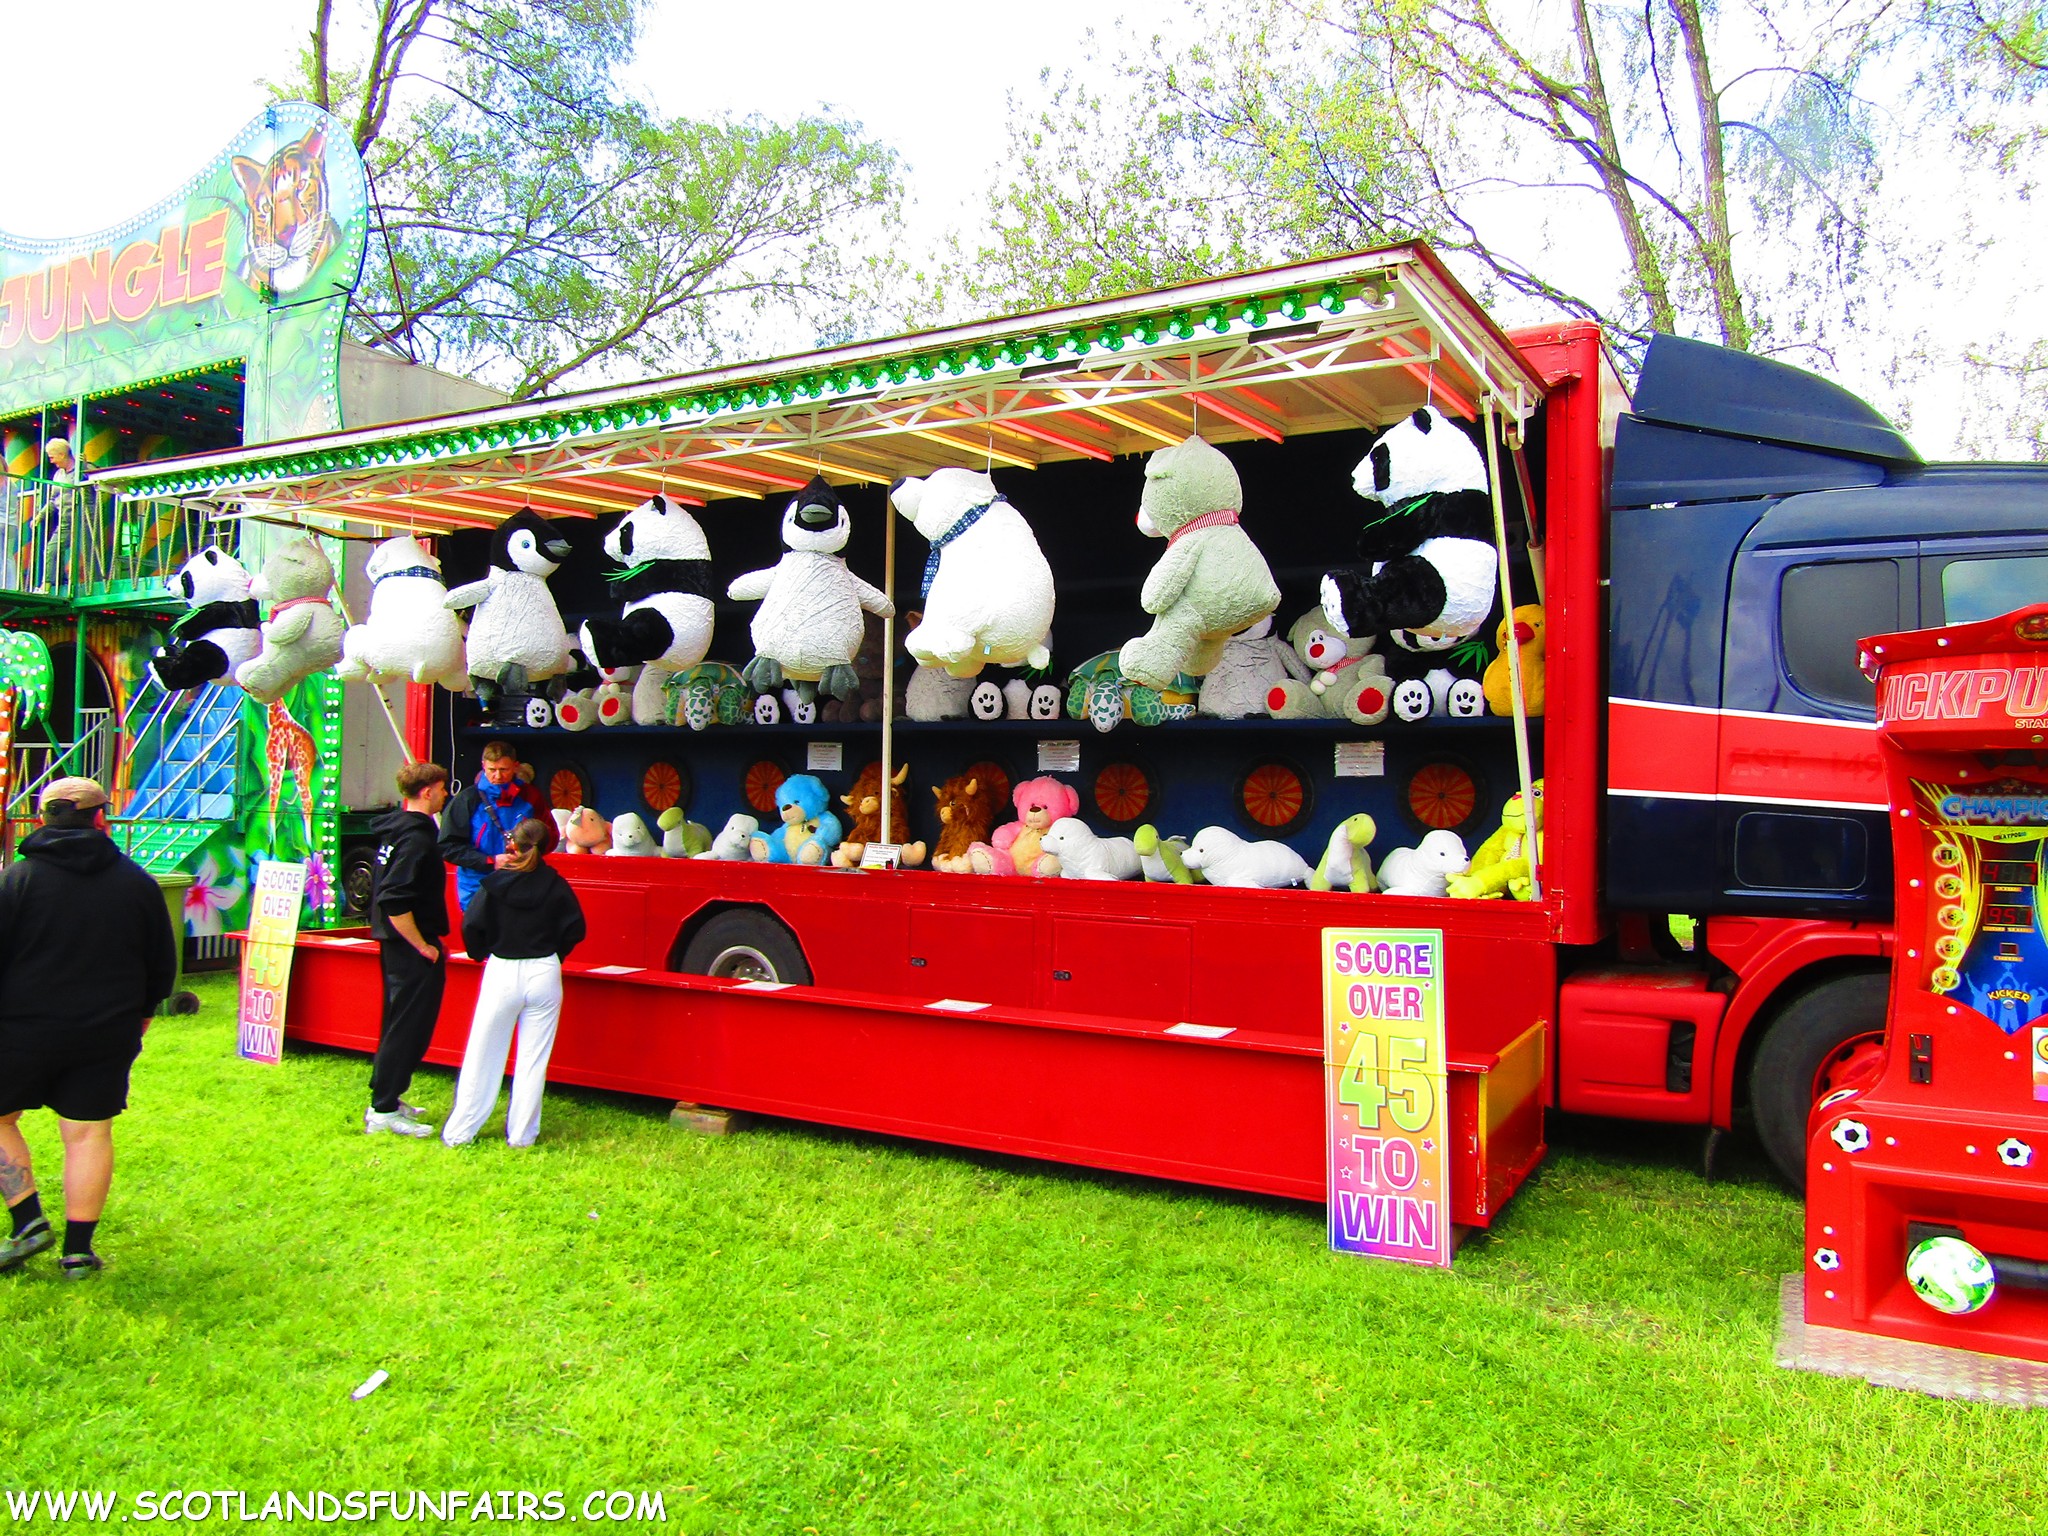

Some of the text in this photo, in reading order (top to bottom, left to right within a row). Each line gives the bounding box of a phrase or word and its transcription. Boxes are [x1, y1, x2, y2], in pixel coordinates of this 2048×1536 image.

[0, 208, 230, 349] JUNGLE
[261, 869, 302, 893] SCORE
[262, 896, 293, 918] OVER
[249, 924, 290, 988] 45
[1335, 941, 1434, 978] SCORE
[251, 989, 276, 1022] TO
[1348, 983, 1424, 1021] OVER
[1987, 990, 2032, 1003] KICKER
[244, 1022, 280, 1059] WIN
[1338, 1031, 1435, 1132] 45
[1351, 1135, 1418, 1191] TO
[1338, 1190, 1437, 1250] WIN
